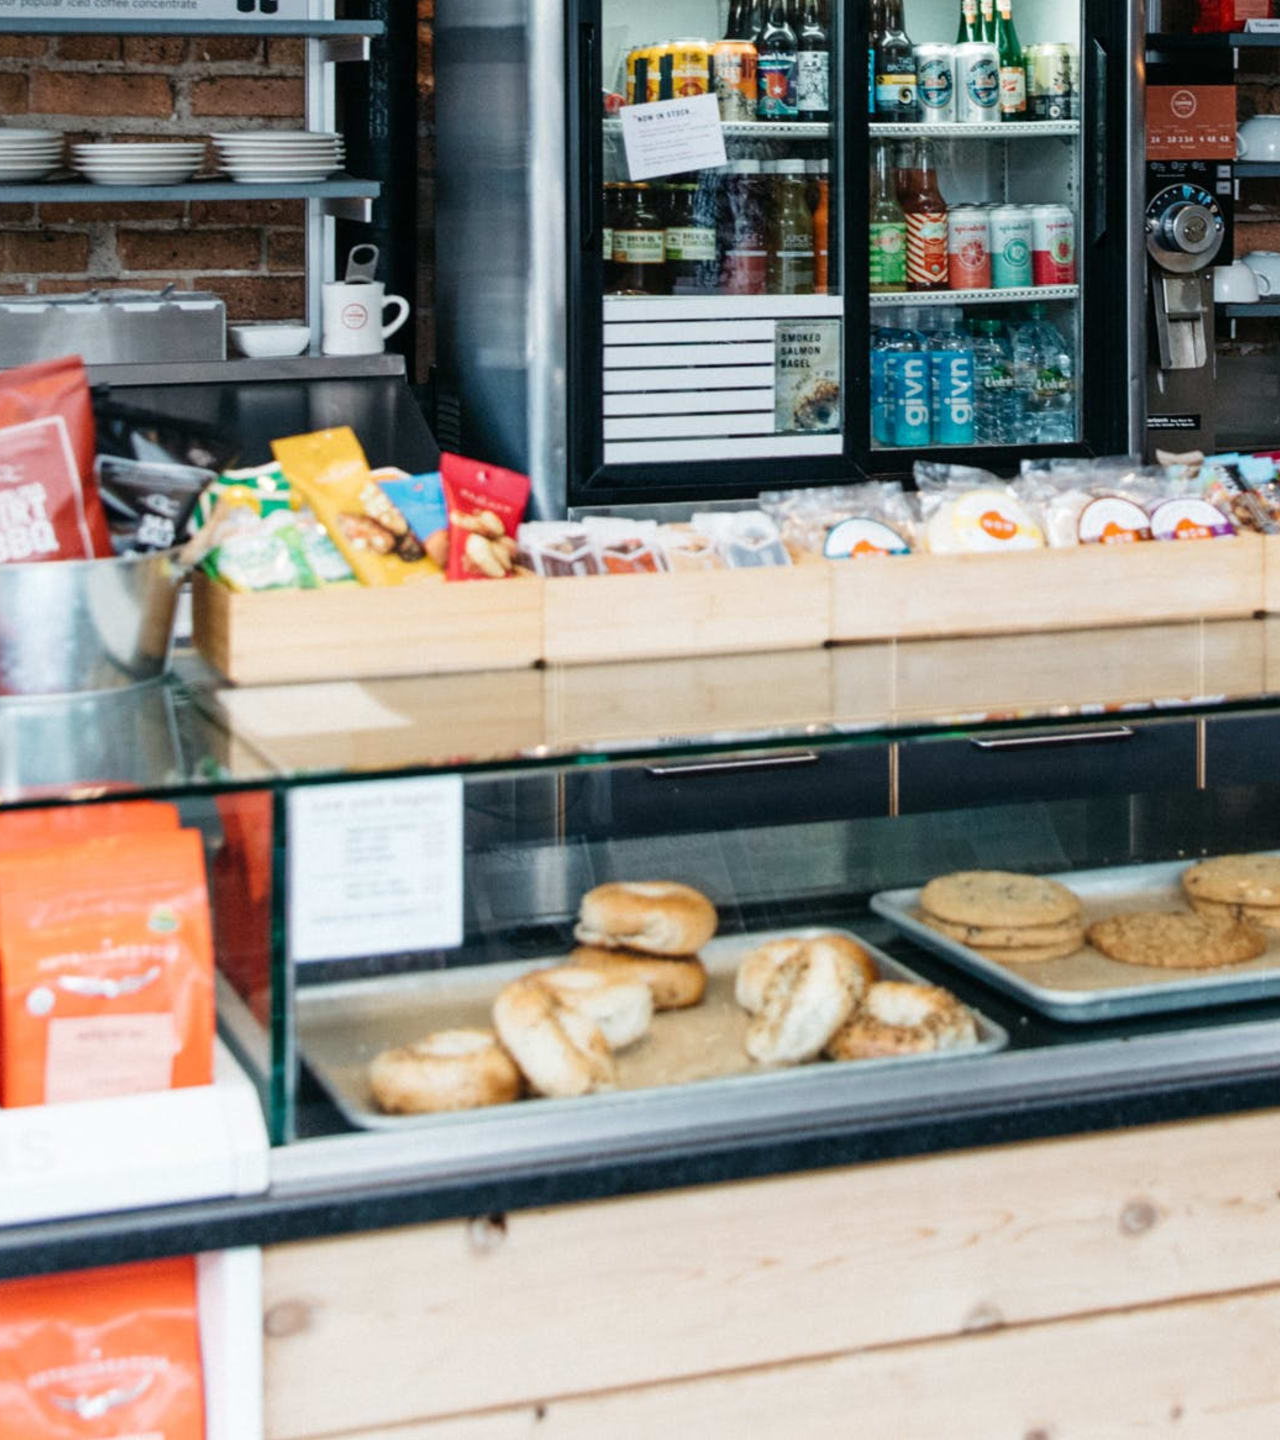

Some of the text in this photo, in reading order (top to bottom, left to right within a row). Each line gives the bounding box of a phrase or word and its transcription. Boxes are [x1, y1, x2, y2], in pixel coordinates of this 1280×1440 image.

[780, 332, 822, 343] SMOKED
[780, 346, 821, 356] SALMON
[780, 358, 811, 369] BAGEL
[898, 358, 929, 427] givn
[943, 357, 973, 425] givn
